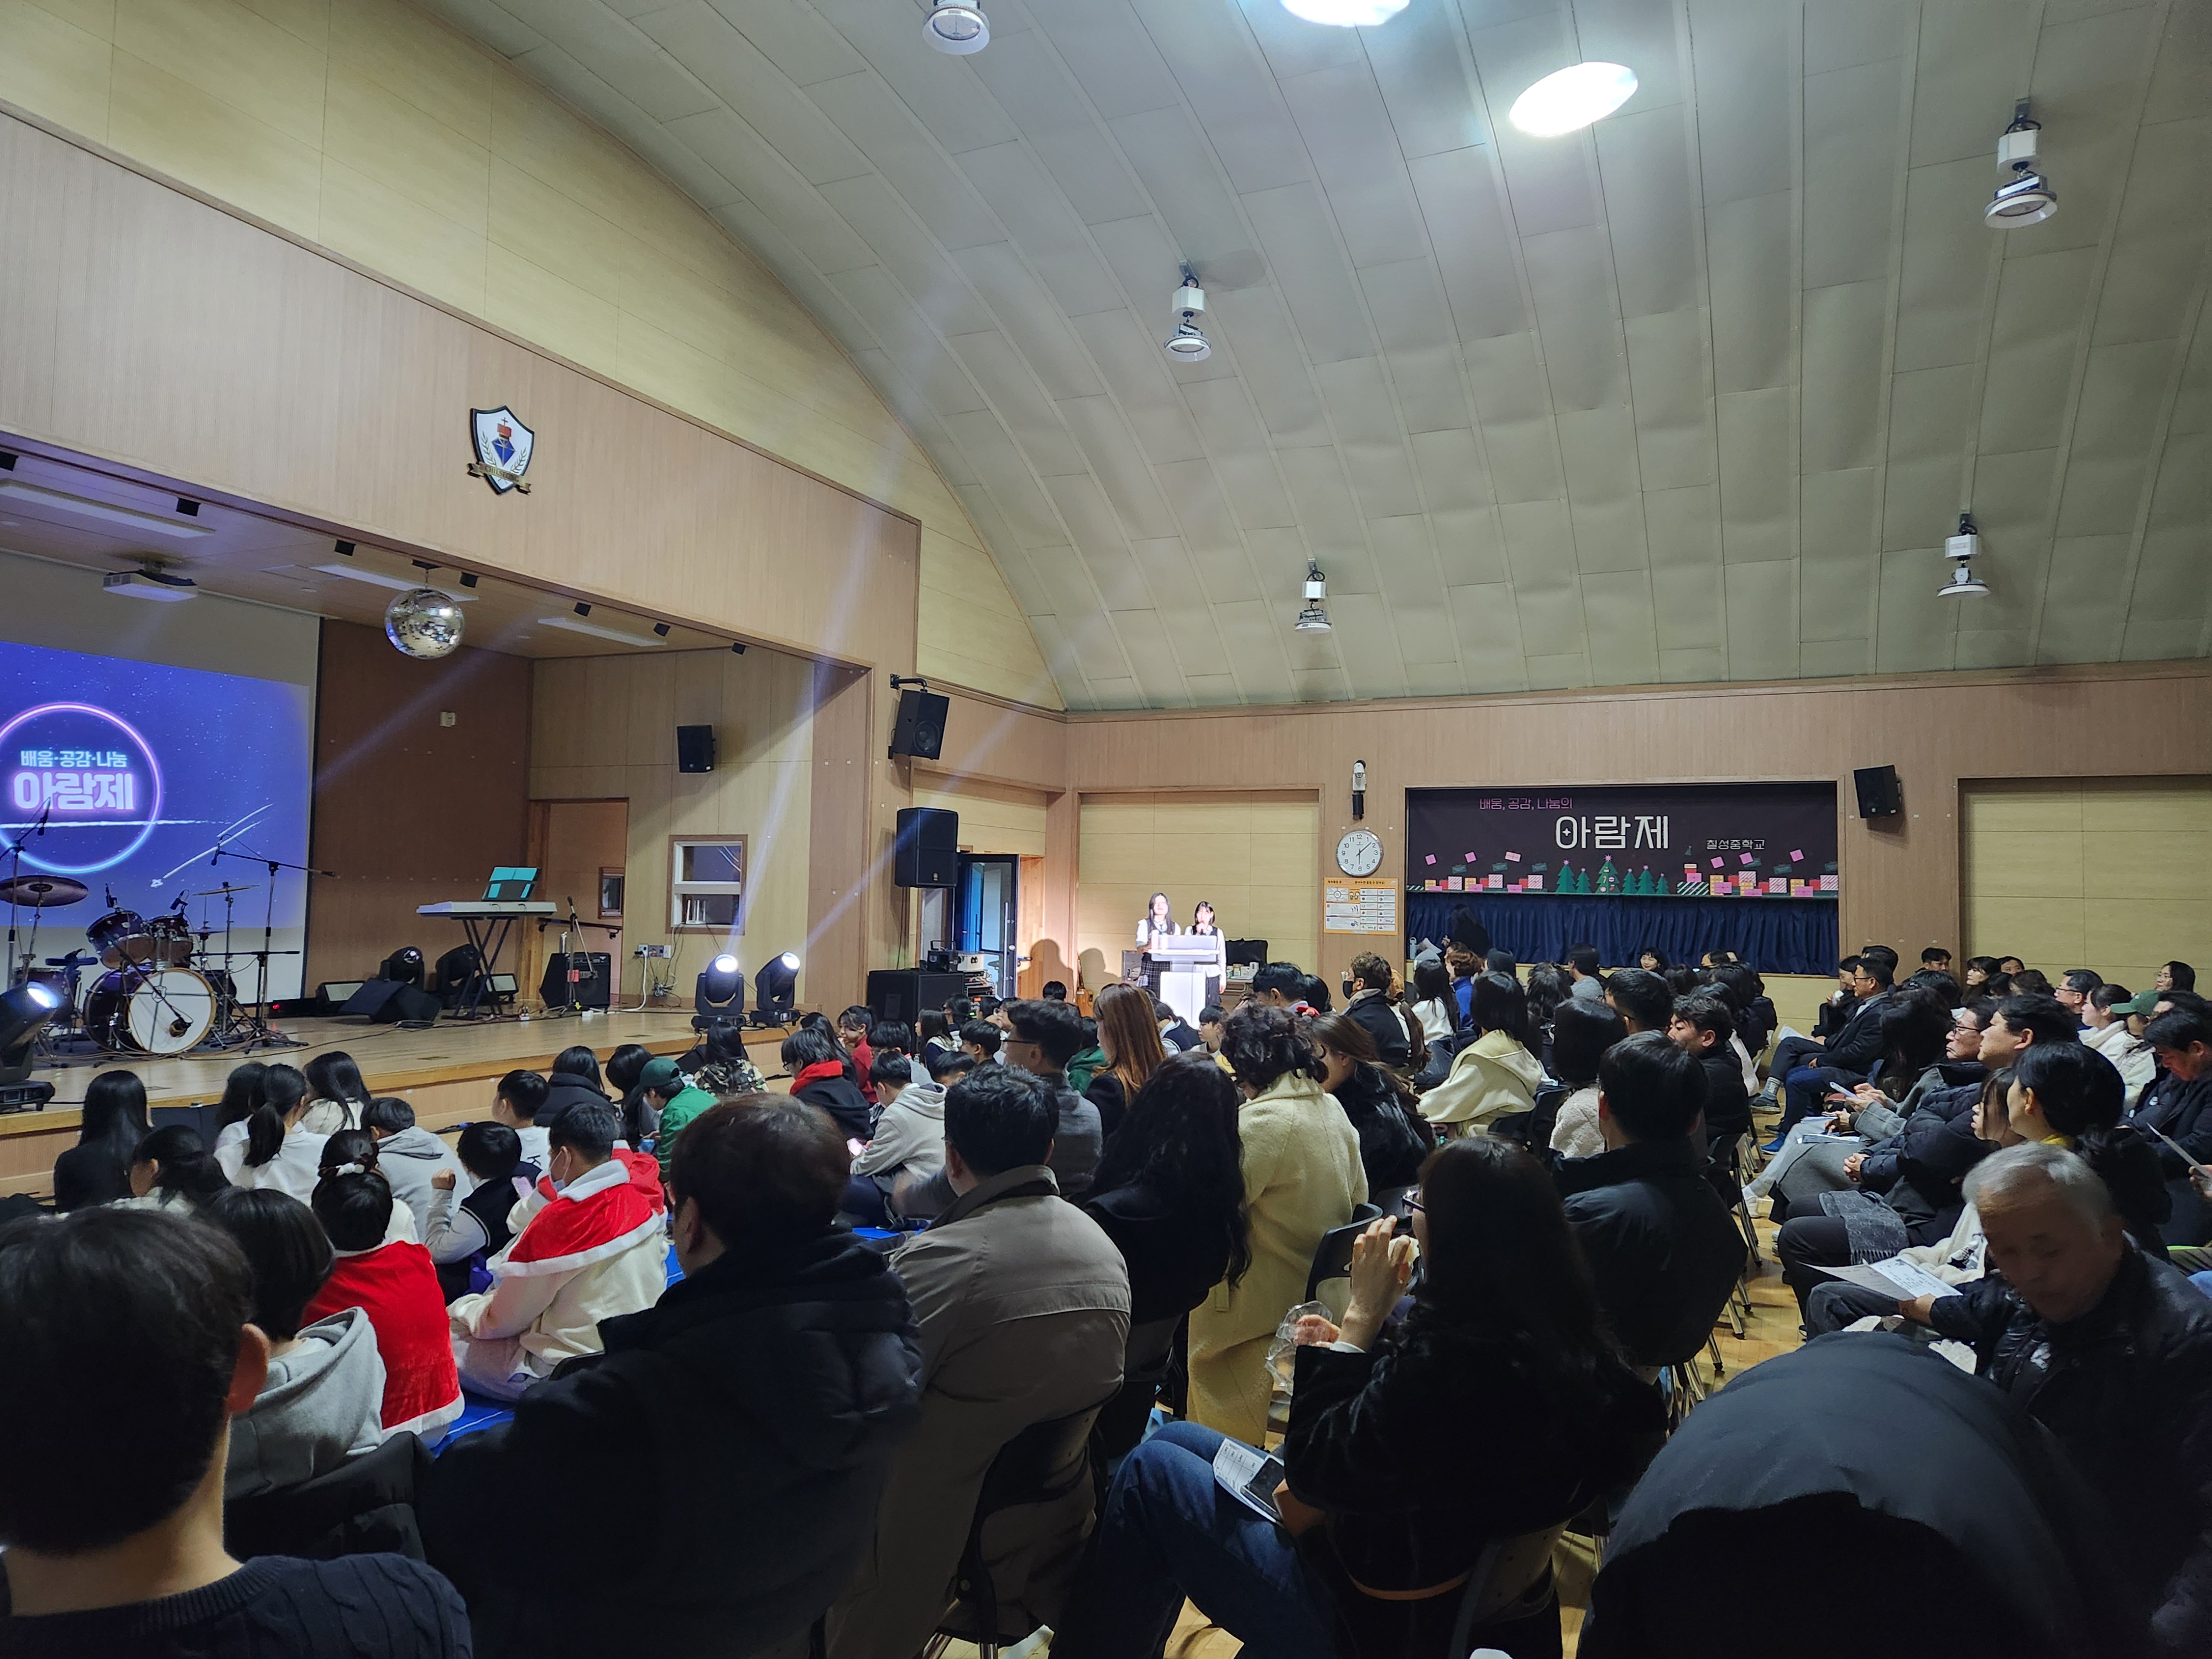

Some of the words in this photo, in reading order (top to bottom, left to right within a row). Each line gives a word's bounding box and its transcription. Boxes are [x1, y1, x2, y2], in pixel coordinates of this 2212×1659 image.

[485, 465, 520, 482] CHILSEONG
[13, 771, 134, 810] 아람제
[1479, 798, 1505, 811] 배움,
[1508, 798, 1535, 811] 공감,
[1537, 797, 1572, 810] 나눔의
[1555, 816, 1669, 850] 아람제
[1706, 839, 1765, 851] 칠성중학교
